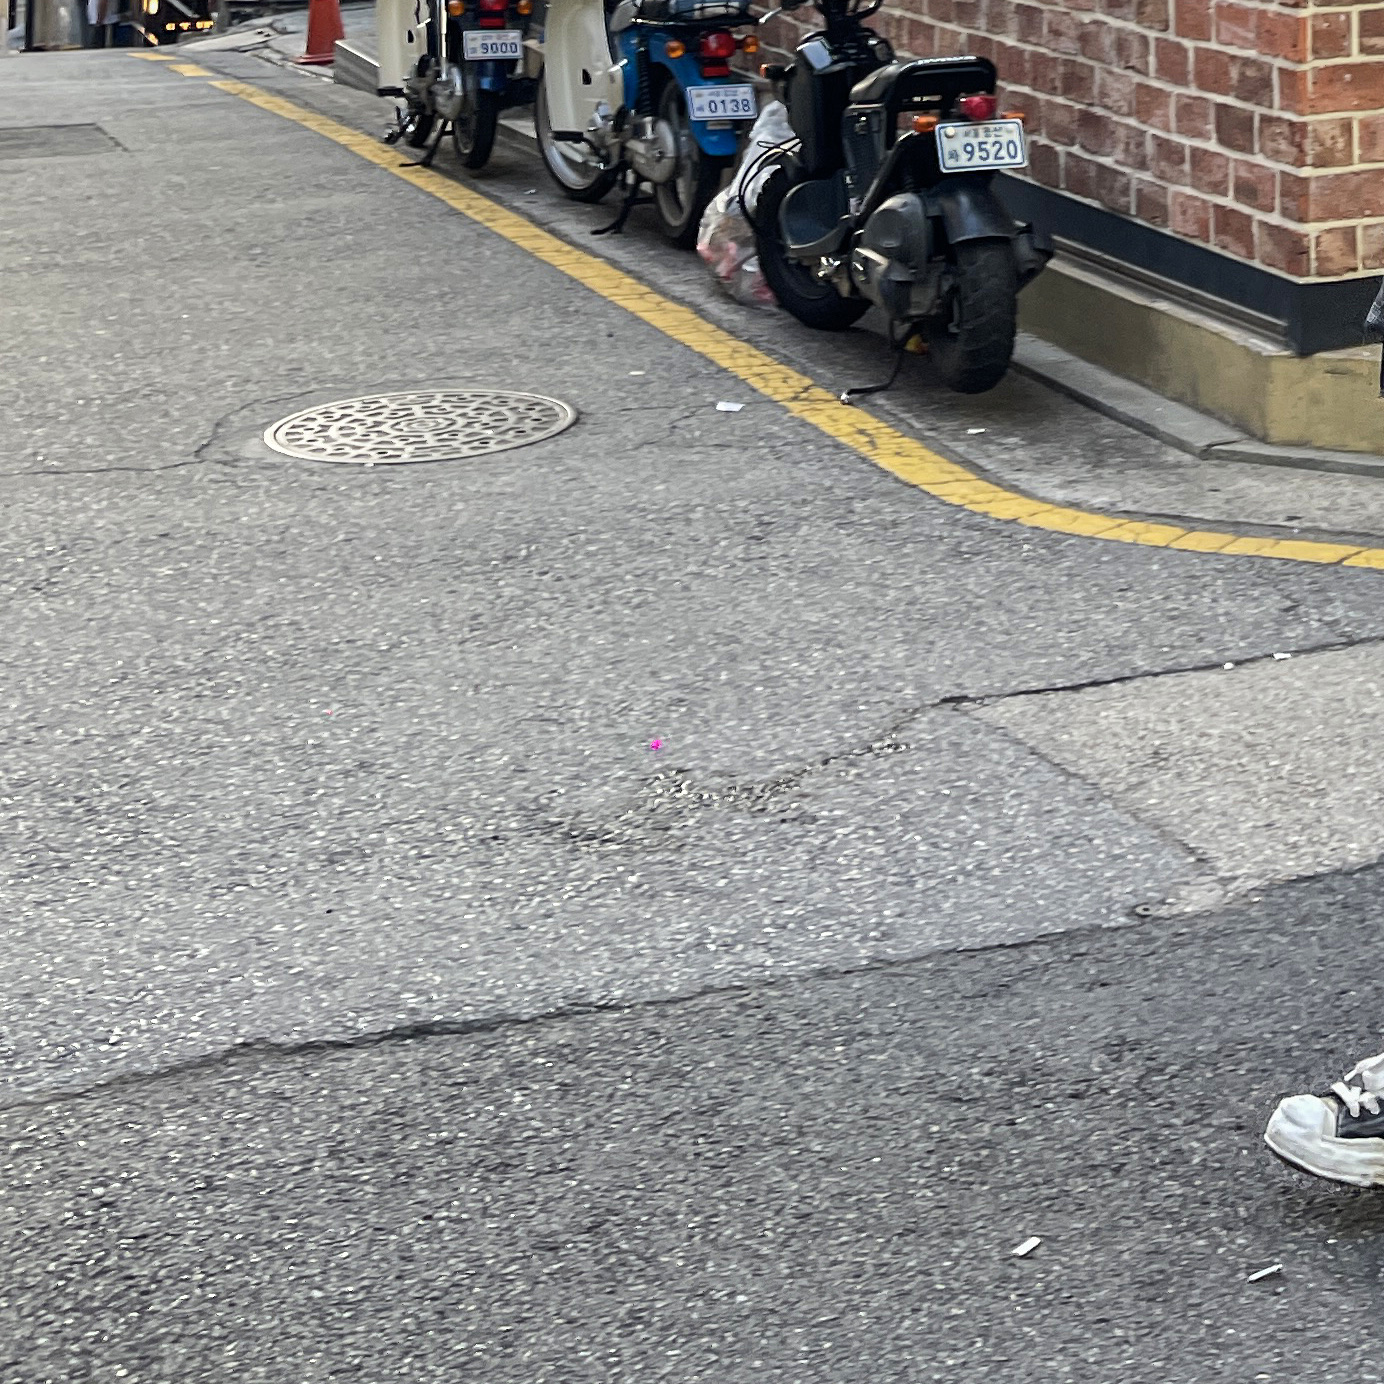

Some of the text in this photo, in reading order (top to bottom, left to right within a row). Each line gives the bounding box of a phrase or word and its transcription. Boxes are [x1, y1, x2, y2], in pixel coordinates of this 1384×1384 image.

[481, 42, 518, 54] 9000
[708, 98, 751, 114] 0138
[963, 139, 1018, 162] 9520
